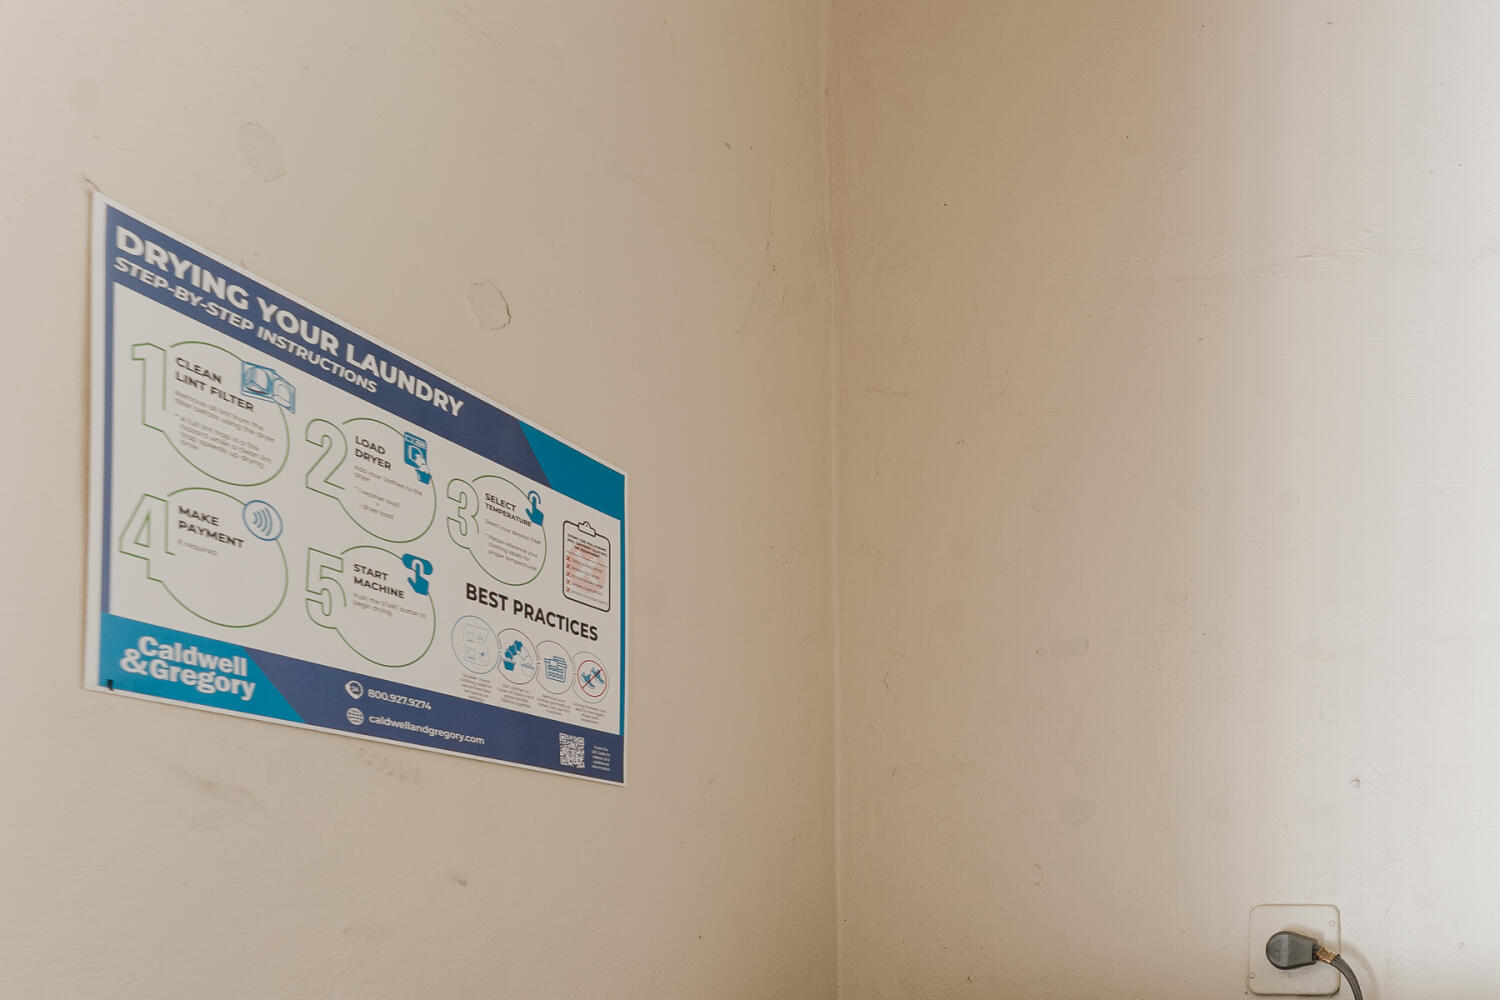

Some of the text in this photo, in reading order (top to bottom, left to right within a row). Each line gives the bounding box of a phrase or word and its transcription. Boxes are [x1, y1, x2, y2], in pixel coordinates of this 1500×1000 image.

[113, 256, 378, 393] STEP-BY-STEP INSTRUCTIONS
[115, 224, 465, 417] DRYING YOUR LAUNDRY
[176, 357, 222, 384] CLEAN
[176, 371, 255, 413] LINT FILTER
[355, 435, 386, 455] LOAD
[355, 448, 392, 471] DRYER
[485, 493, 516, 512] SELECT
[485, 503, 532, 528] TEMPERATURE
[178, 505, 220, 527] MAKE
[178, 520, 245, 549] PAYMENT
[353, 563, 389, 581] START
[353, 576, 405, 599] MACHINE
[466, 582, 508, 612] BEST
[513, 599, 599, 642] PRACTICES
[138, 636, 248, 677] Caldwell
[367, 688, 432, 711] 800.927.9274
[368, 714, 486, 745] caldwellandgregory.com
